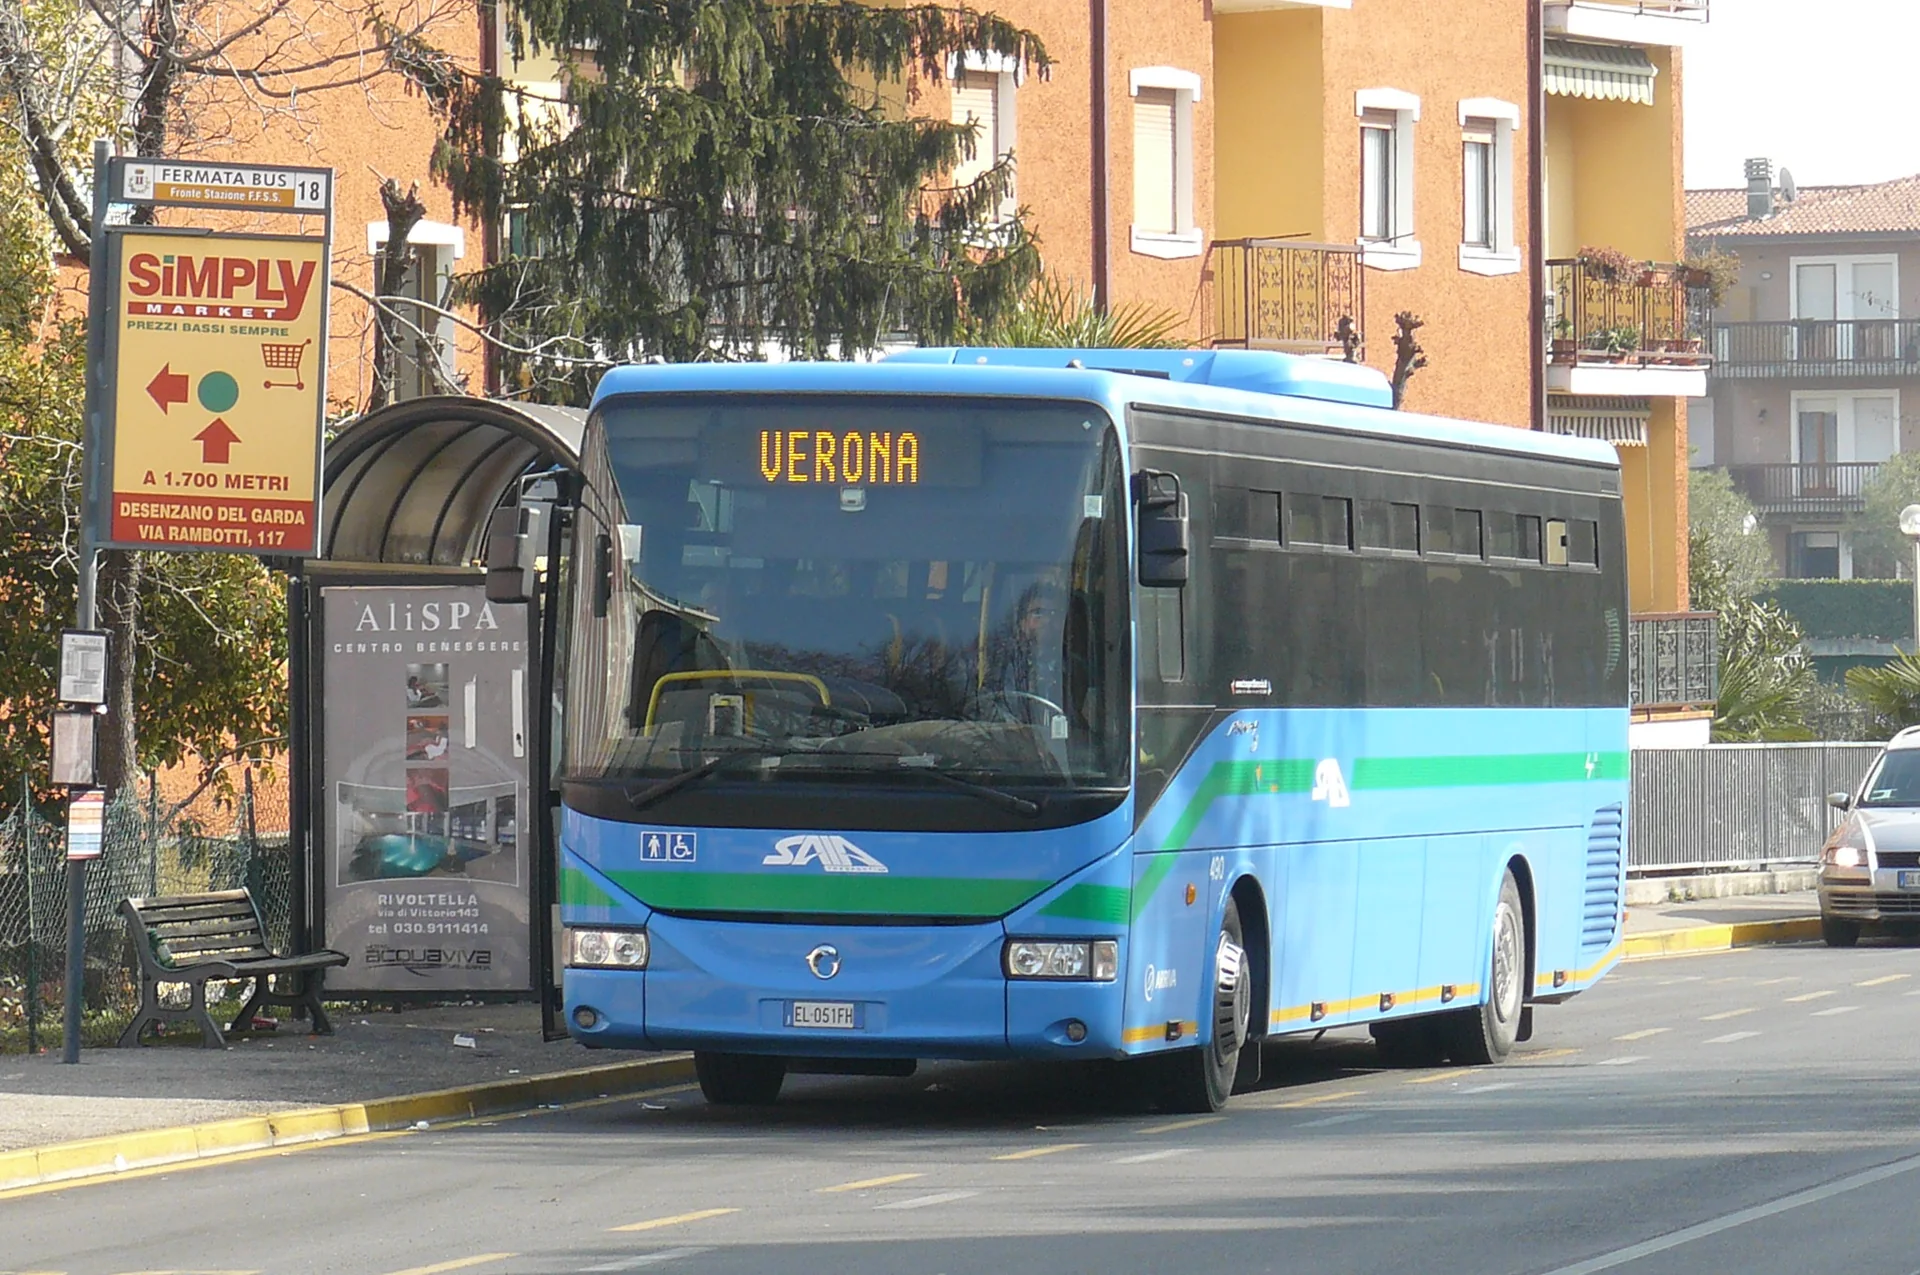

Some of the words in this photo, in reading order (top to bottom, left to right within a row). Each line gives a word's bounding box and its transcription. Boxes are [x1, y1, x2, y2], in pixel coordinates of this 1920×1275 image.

[161, 169, 245, 186] FERMATA
[252, 173, 287, 188] BUS
[170, 186, 201, 199] Fronte
[204, 188, 245, 201] Stazione
[248, 191, 281, 203] F.F.S.S.
[298, 181, 320, 201] 18
[146, 304, 276, 319] MARKET
[127, 320, 178, 332] PREZZI
[182, 322, 225, 334] BASSI
[230, 325, 289, 337] SEMPRE
[760, 430, 919, 483] VERONA
[143, 470, 156, 485] A
[164, 472, 218, 488] 1.700
[224, 474, 289, 491] METRI
[120, 502, 213, 521] DESENZANO
[217, 507, 247, 522] DEL
[251, 509, 305, 525] GARDA
[138, 524, 164, 540] VIA
[168, 526, 252, 546] RAMBOTTI,
[257, 531, 285, 545] 117
[356, 601, 499, 631] AliSPA
[334, 643, 402, 653] CENTRO
[416, 641, 520, 652] BENESSERE
[378, 894, 478, 905] RIVOLTELLA
[378, 908, 394, 917] via
[397, 908, 407, 917] di
